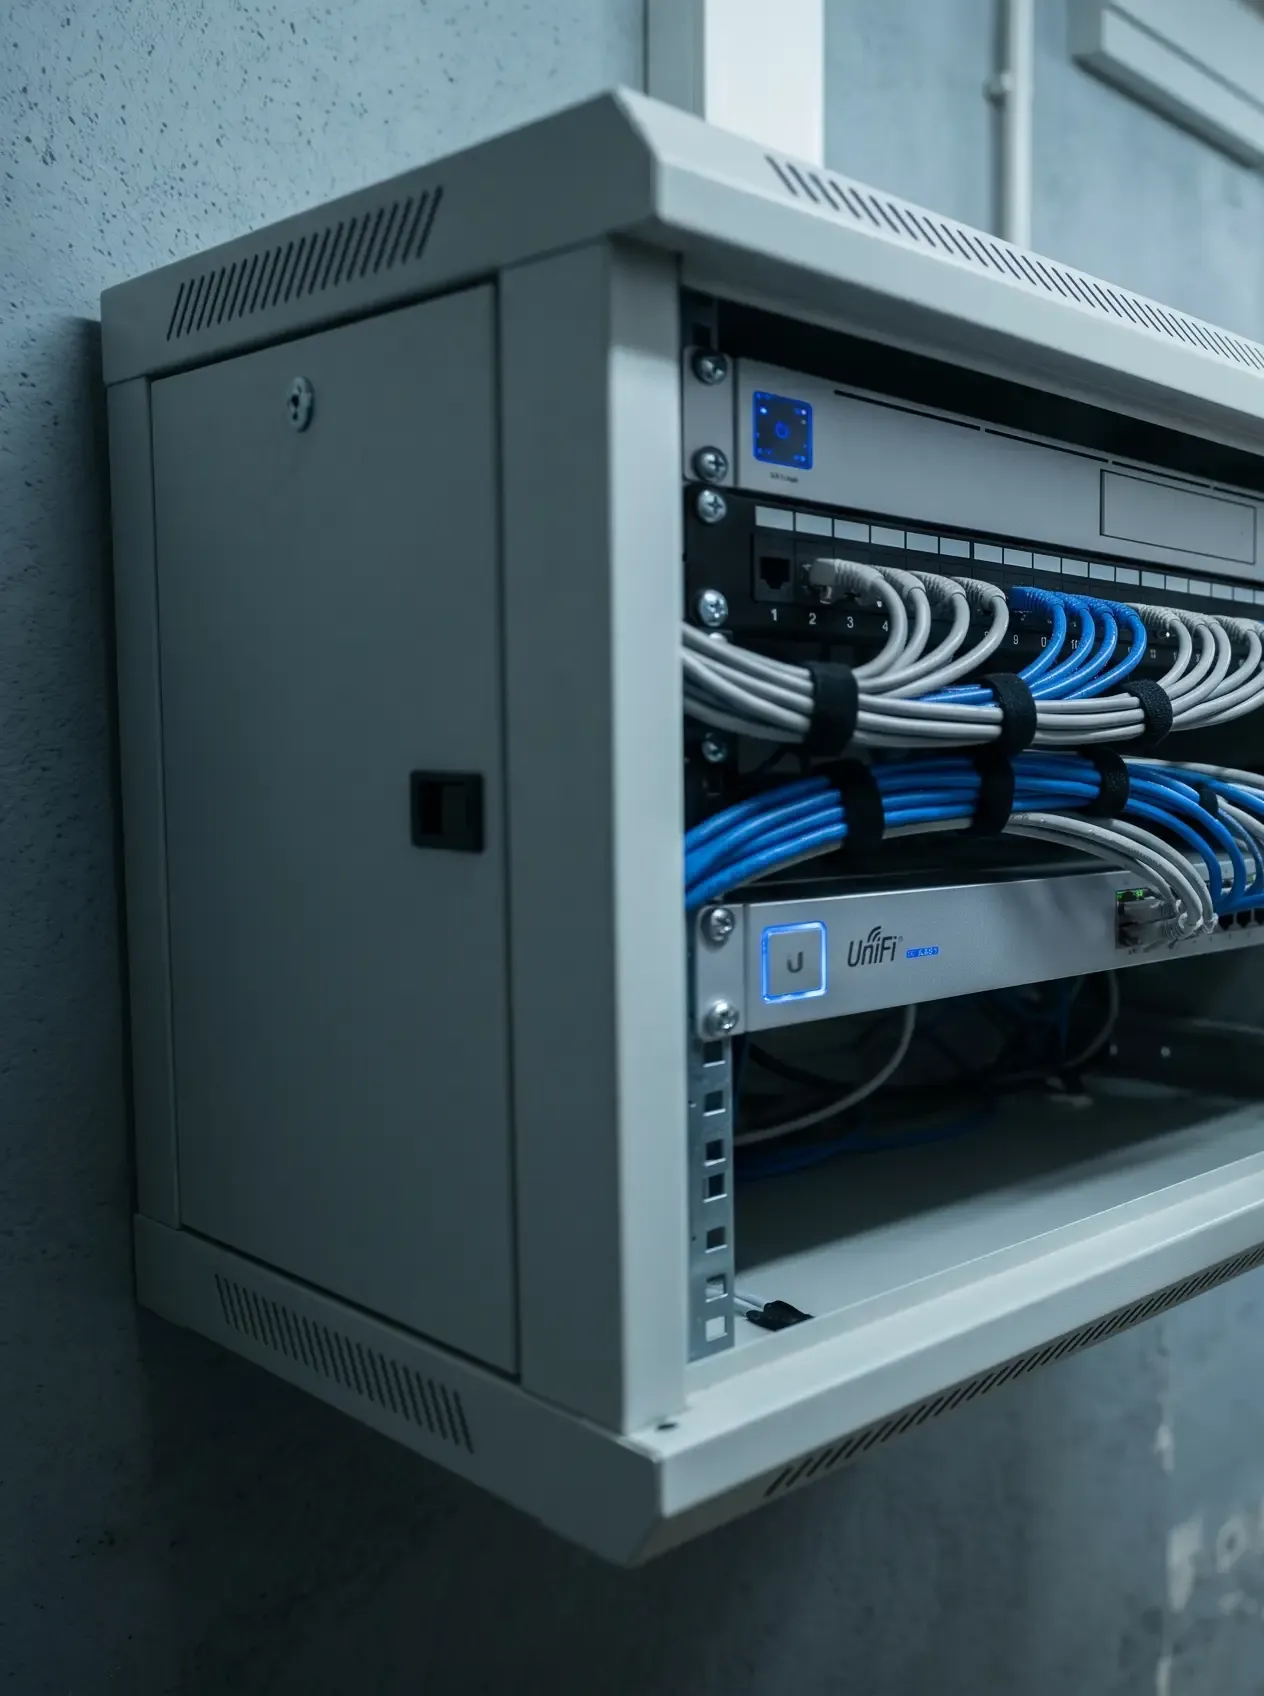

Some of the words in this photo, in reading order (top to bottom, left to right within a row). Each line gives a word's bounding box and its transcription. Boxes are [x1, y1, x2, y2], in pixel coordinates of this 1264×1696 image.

[771, 608, 777, 621] 1
[809, 612, 816, 625] 2
[847, 616, 854, 628] 3
[882, 620, 888, 632] 4
[1013, 635, 1019, 645] 9
[847, 933, 899, 968] UniFi
